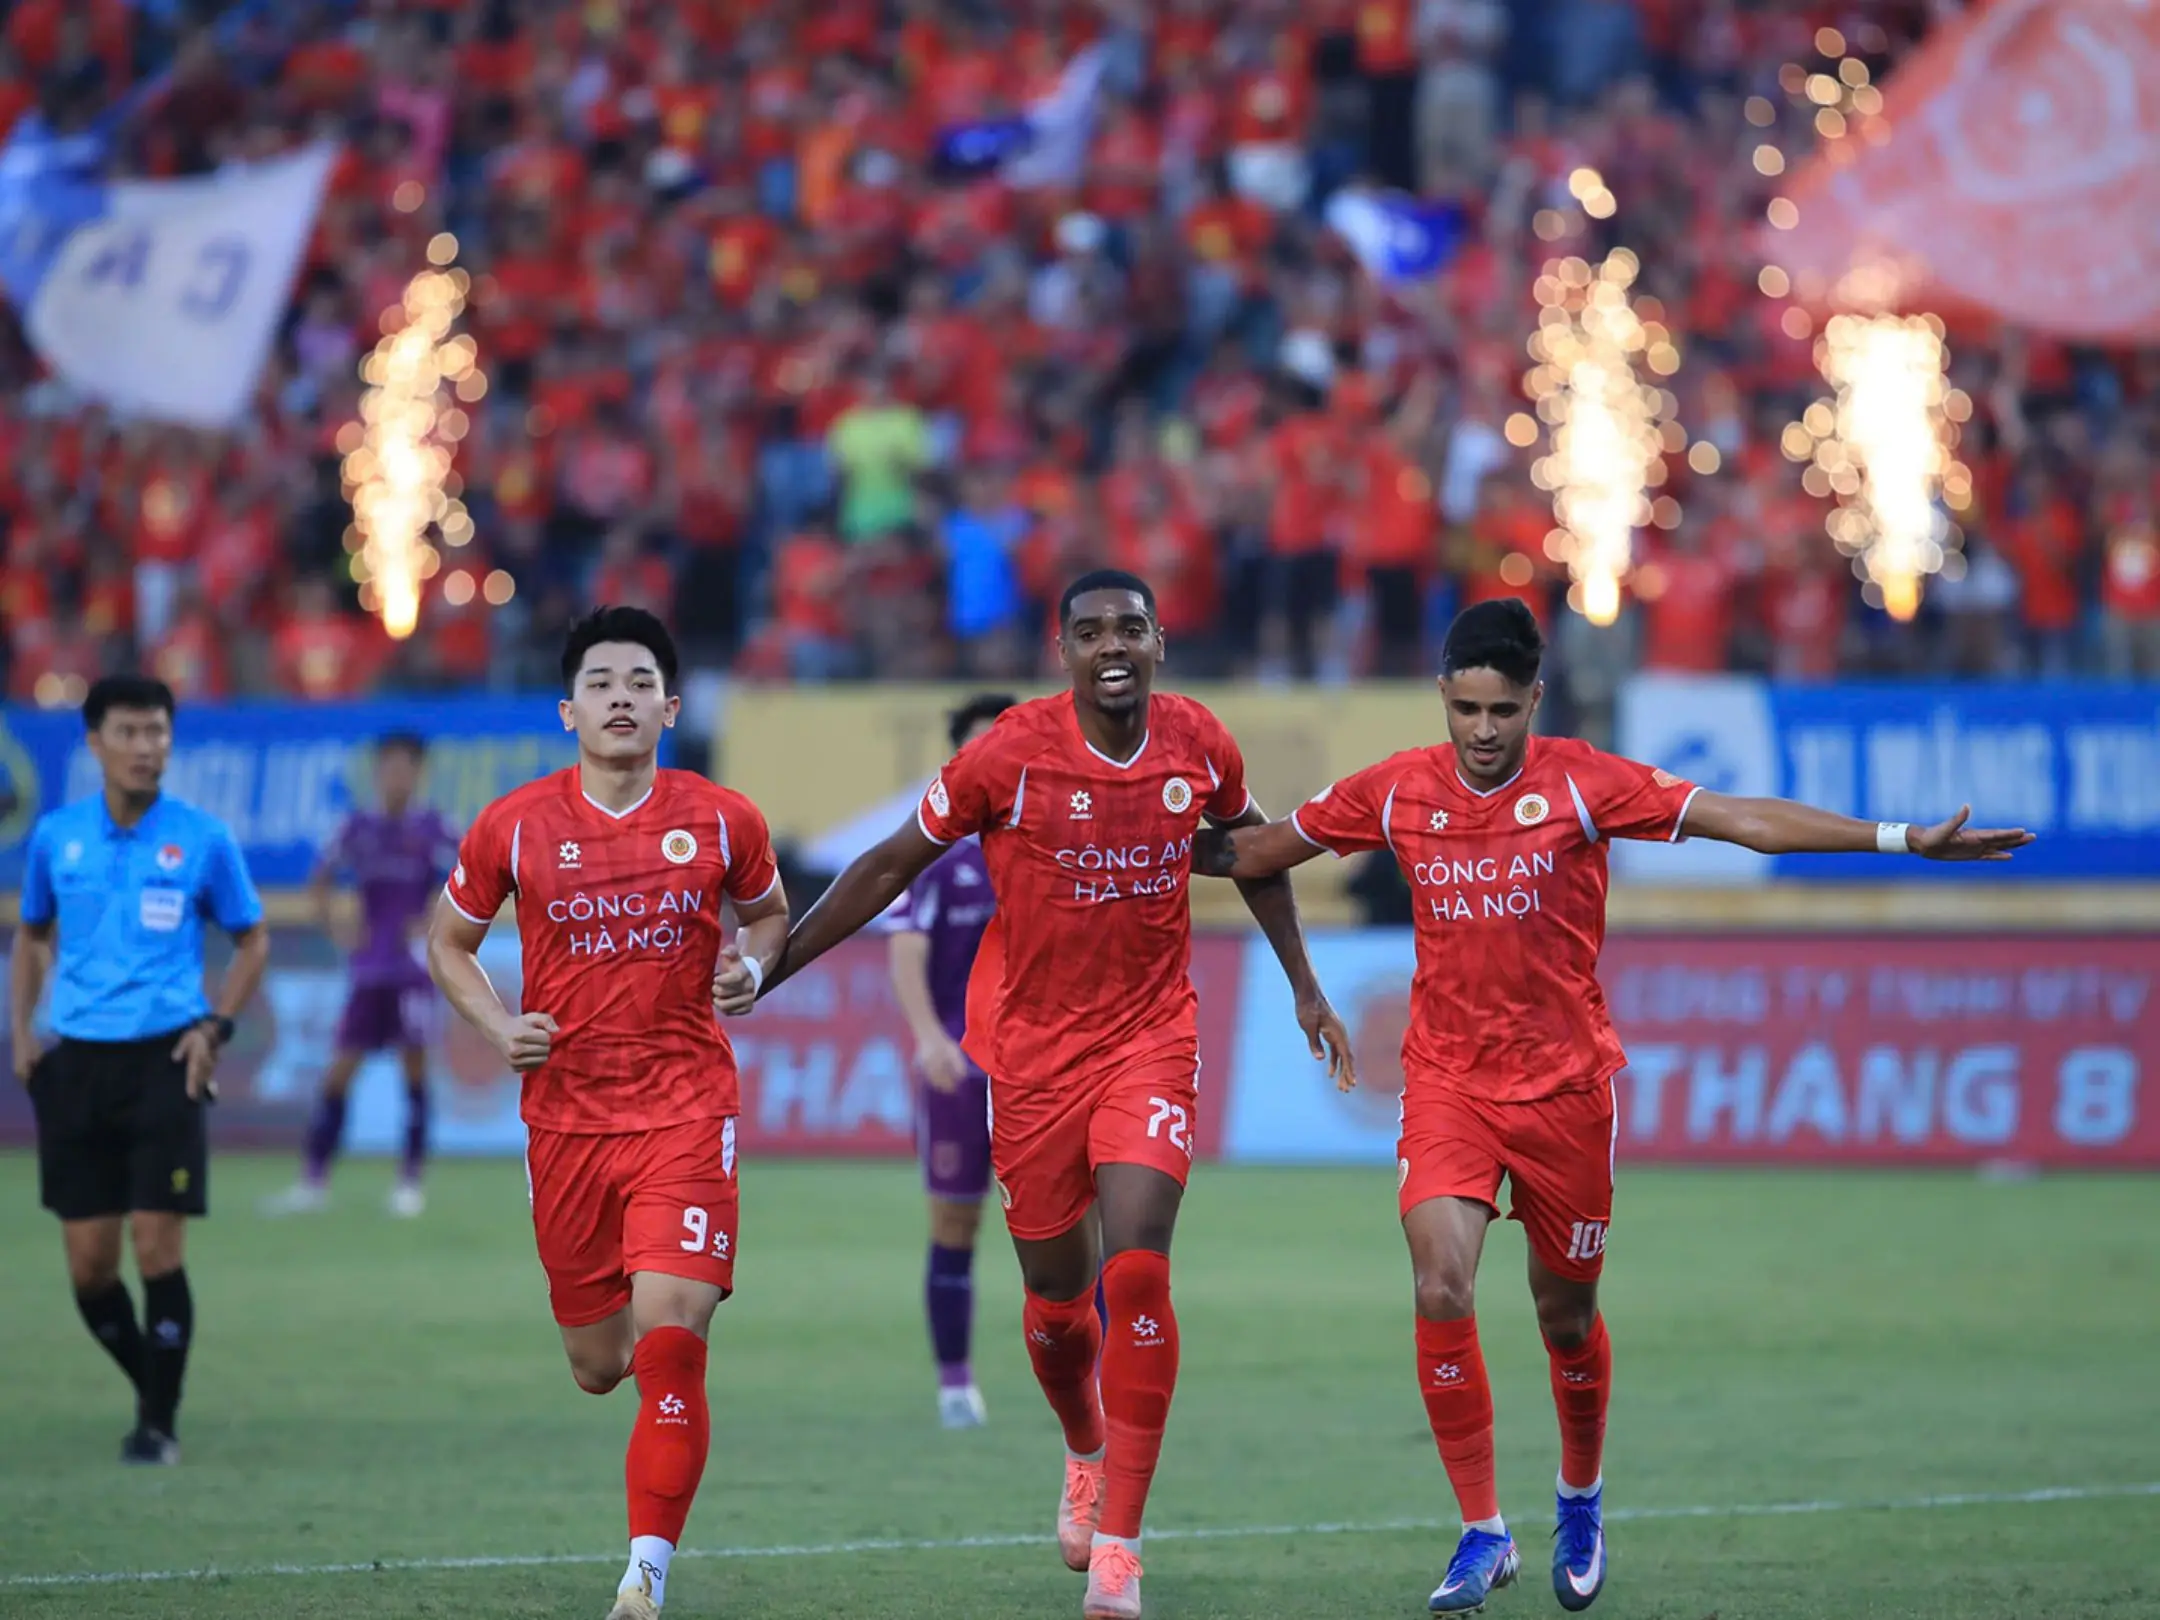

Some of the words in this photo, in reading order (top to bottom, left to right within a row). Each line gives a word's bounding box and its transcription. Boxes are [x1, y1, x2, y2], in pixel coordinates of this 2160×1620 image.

[1055, 843, 1150, 871] CÔNG
[1159, 833, 1193, 866] AN
[1414, 855, 1498, 886] CÔNG
[1507, 850, 1555, 881] AN
[547, 891, 647, 923] CÔNG
[657, 889, 703, 914] AN
[1074, 875, 1121, 903] HÀ
[1430, 889, 1474, 921] HÀ
[1482, 884, 1541, 921] NỘI
[569, 924, 617, 956] HÀ
[627, 919, 683, 954] NỘI
[2052, 1042, 2138, 1147] 8
[1147, 1096, 1187, 1152] 72
[680, 1206, 708, 1252] 9
[1566, 1221, 1602, 1259] 10
